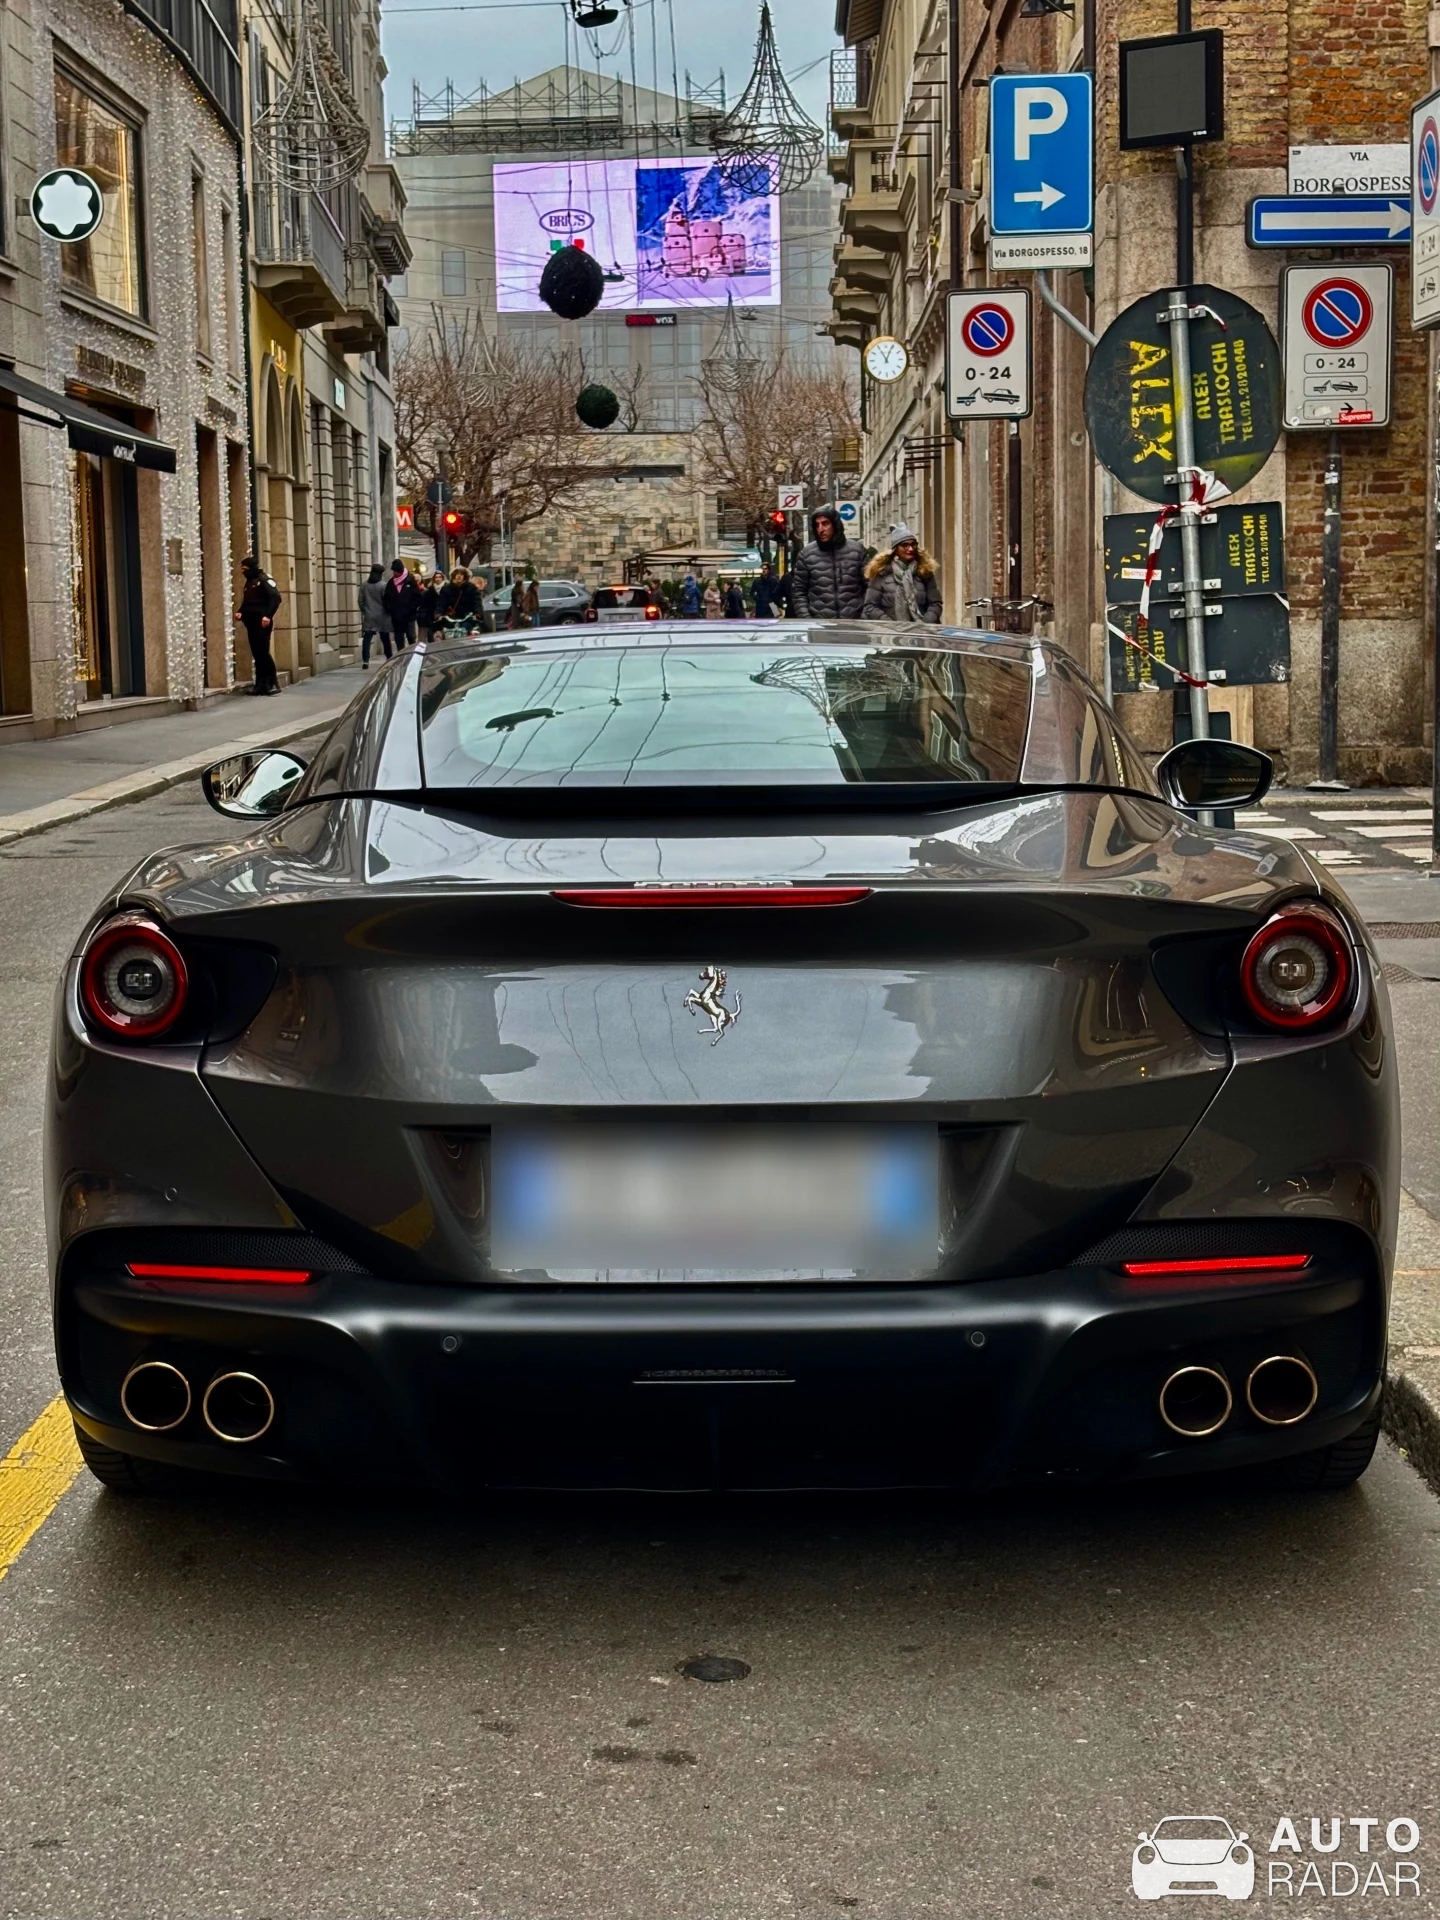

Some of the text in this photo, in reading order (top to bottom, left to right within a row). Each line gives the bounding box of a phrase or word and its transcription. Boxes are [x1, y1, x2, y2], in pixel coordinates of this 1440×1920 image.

[1014, 86, 1068, 161] P
[1350, 151, 1370, 162] VIA
[1293, 175, 1412, 193] BORGOSPESS
[994, 249, 1007, 258] Via
[1080, 246, 1088, 255] 18
[988, 365, 1012, 381] 24
[1337, 357, 1356, 369] 24
[1128, 340, 1174, 464] ALEX
[1193, 371, 1212, 420] ALEX
[1211, 342, 1236, 445] TRASLOCHI
[1233, 339, 1253, 442] TEL.02.2820448
[1340, 413, 1372, 423] Supreme
[1229, 533, 1240, 567] ALEX
[1242, 514, 1257, 586] TRASLOCHI
[1137, 617, 1152, 682] RASLOCHI
[1153, 629, 1166, 663] ALEX
